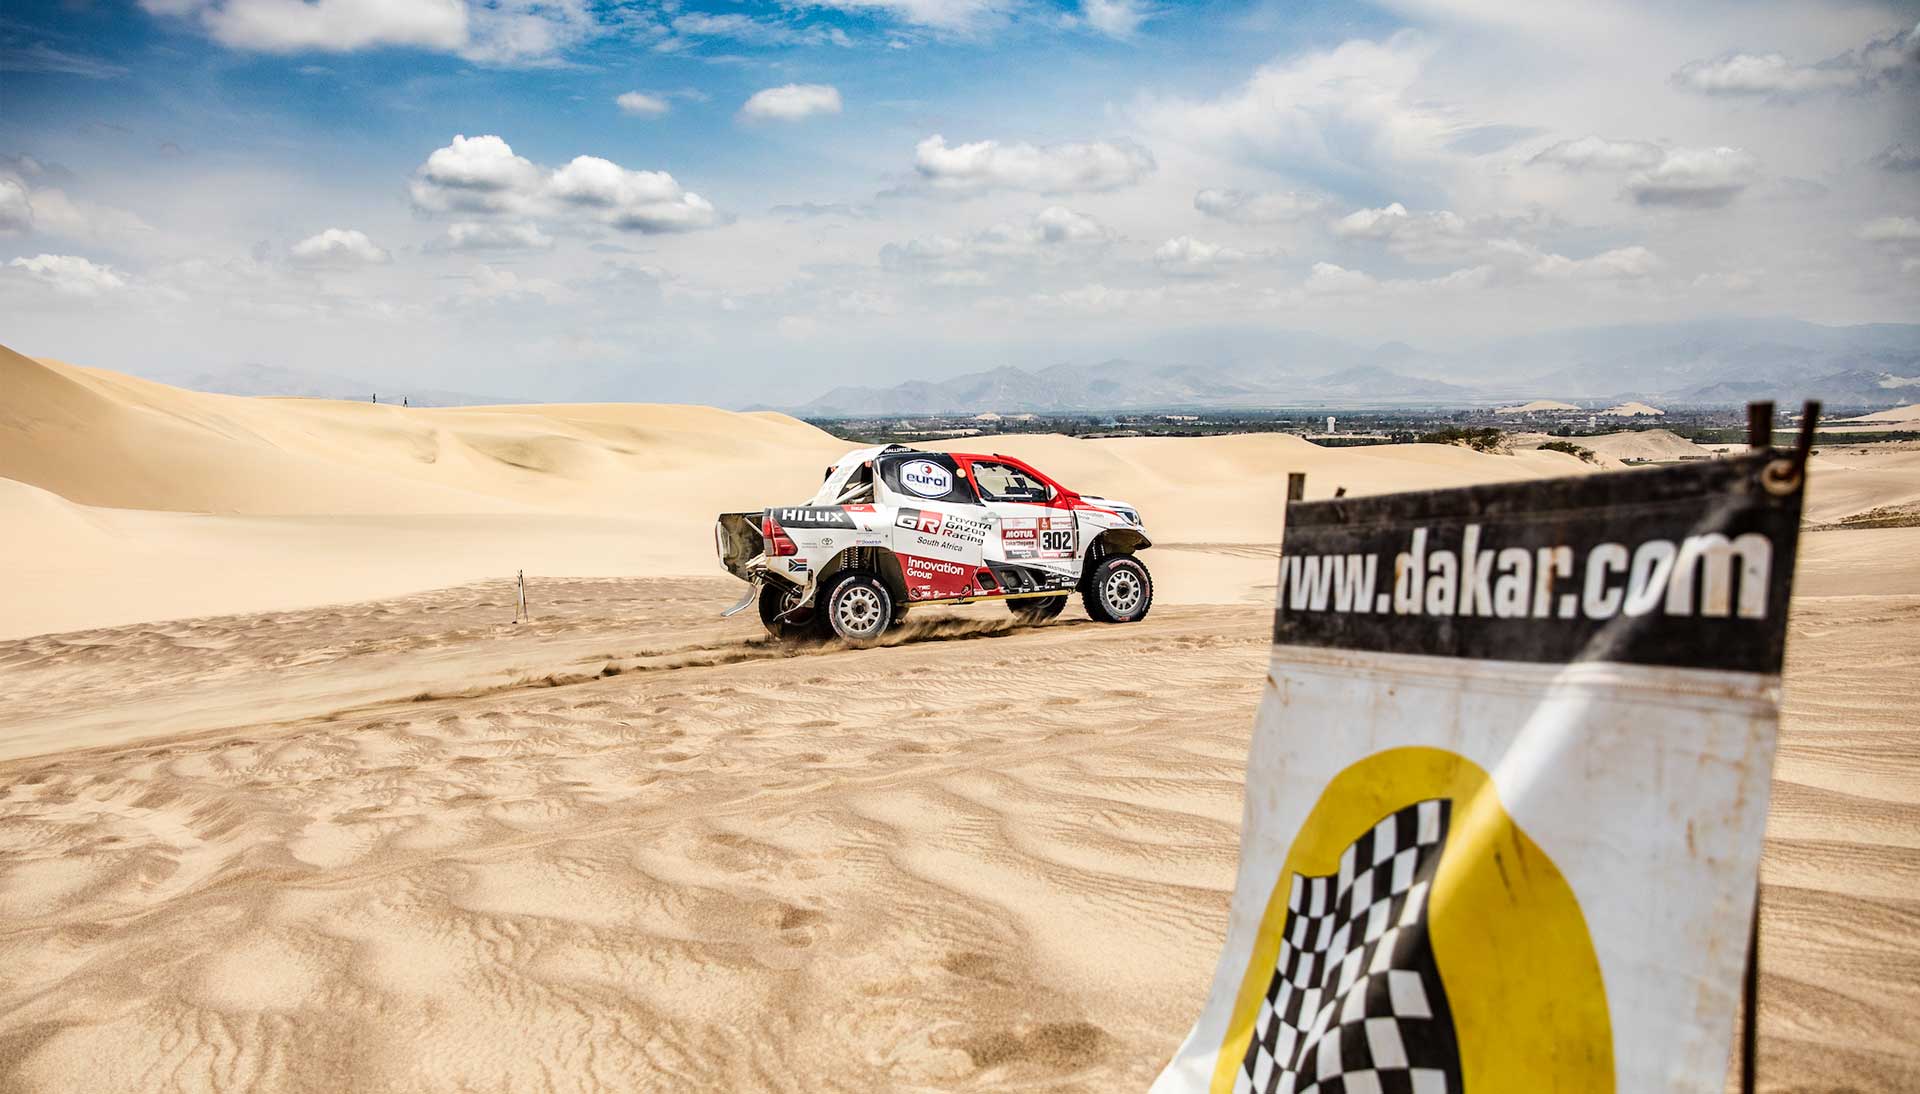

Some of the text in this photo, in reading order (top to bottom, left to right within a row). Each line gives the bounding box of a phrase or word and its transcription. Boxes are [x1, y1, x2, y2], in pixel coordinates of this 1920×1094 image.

[906, 473, 947, 487] eurol
[781, 509, 844, 523] HILUX
[896, 515, 940, 534] GR
[942, 529, 984, 546] Racing
[1005, 530, 1034, 538] MOTUL
[1042, 531, 1072, 550] 302
[917, 536, 963, 552] South Africa
[906, 568, 933, 580] Group
[908, 556, 964, 576] Innovation
[1276, 525, 1773, 620] ww.dakar.com
